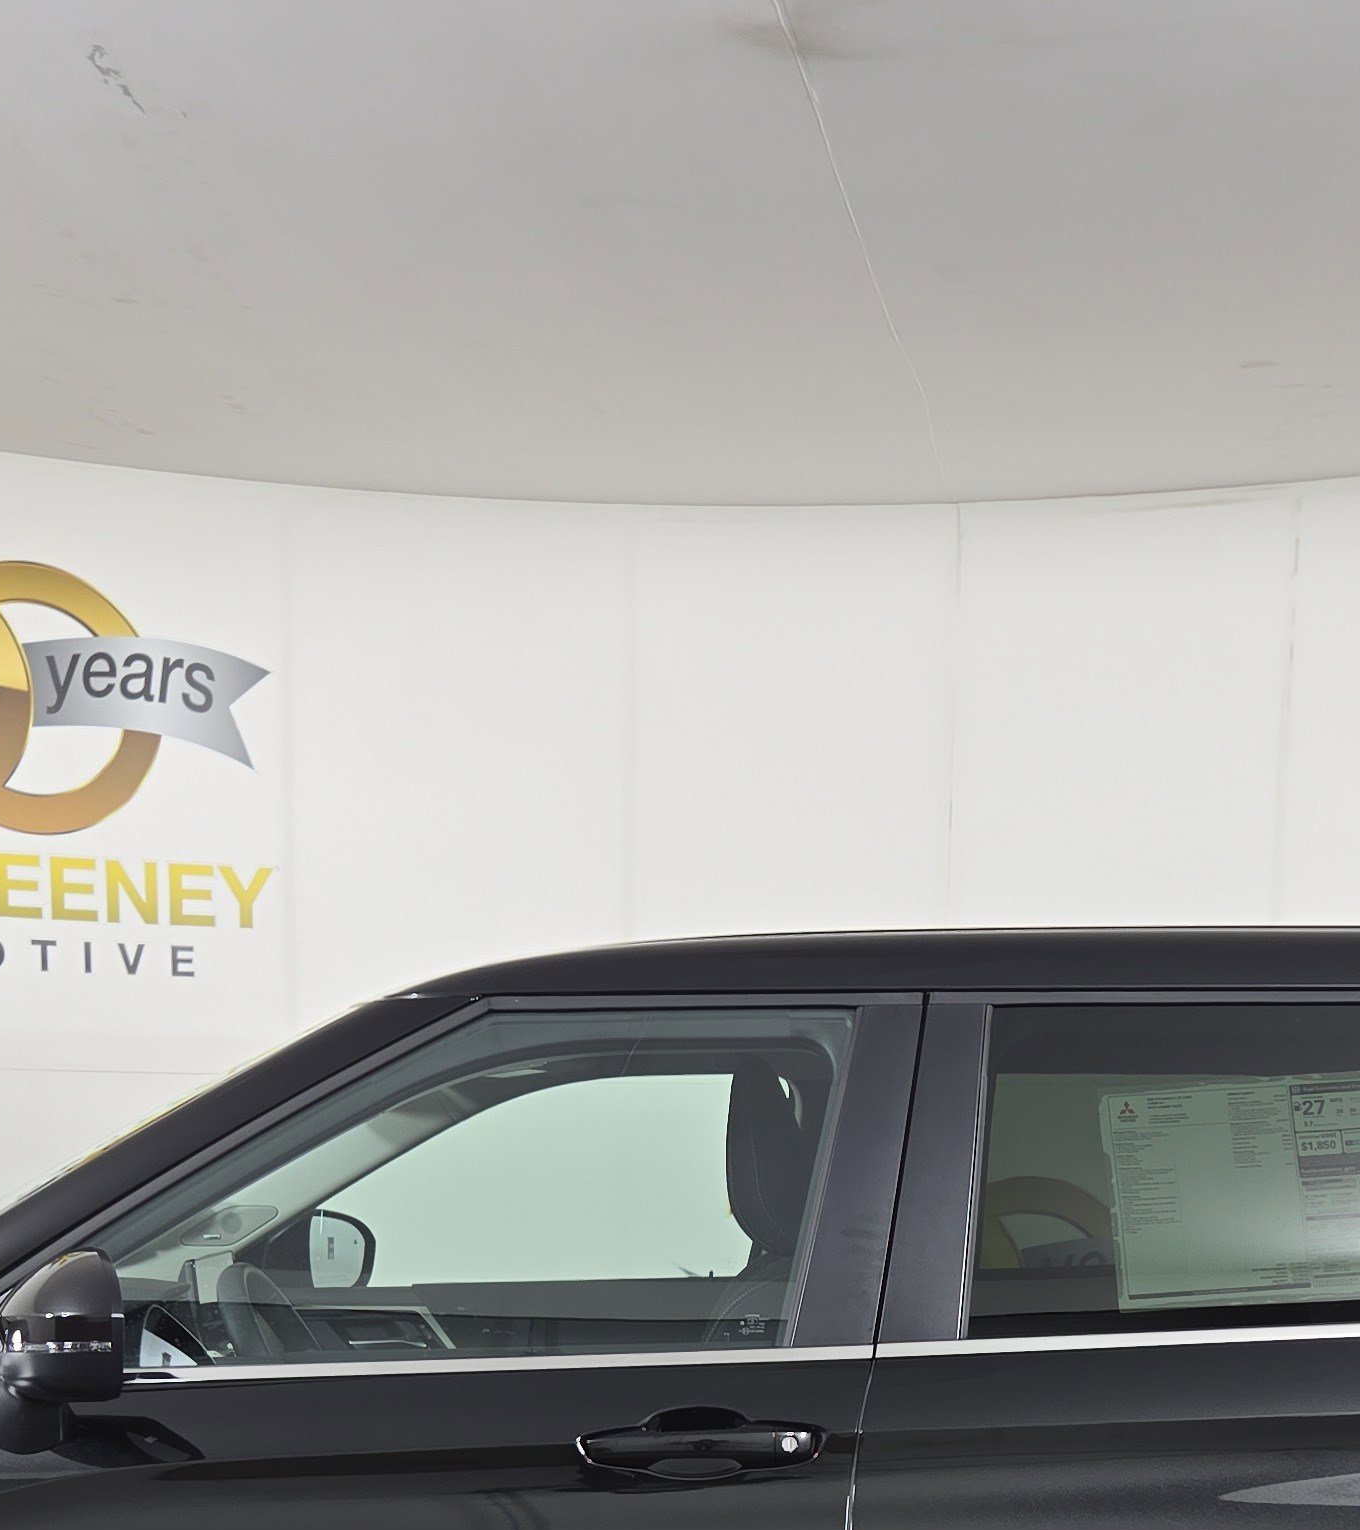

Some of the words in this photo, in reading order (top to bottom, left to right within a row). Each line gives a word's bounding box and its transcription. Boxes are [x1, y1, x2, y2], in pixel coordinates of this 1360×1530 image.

[45, 648, 215, 715] years
[1302, 1100, 1325, 1116] 27
[1301, 1140, 1337, 1152] $1,850
